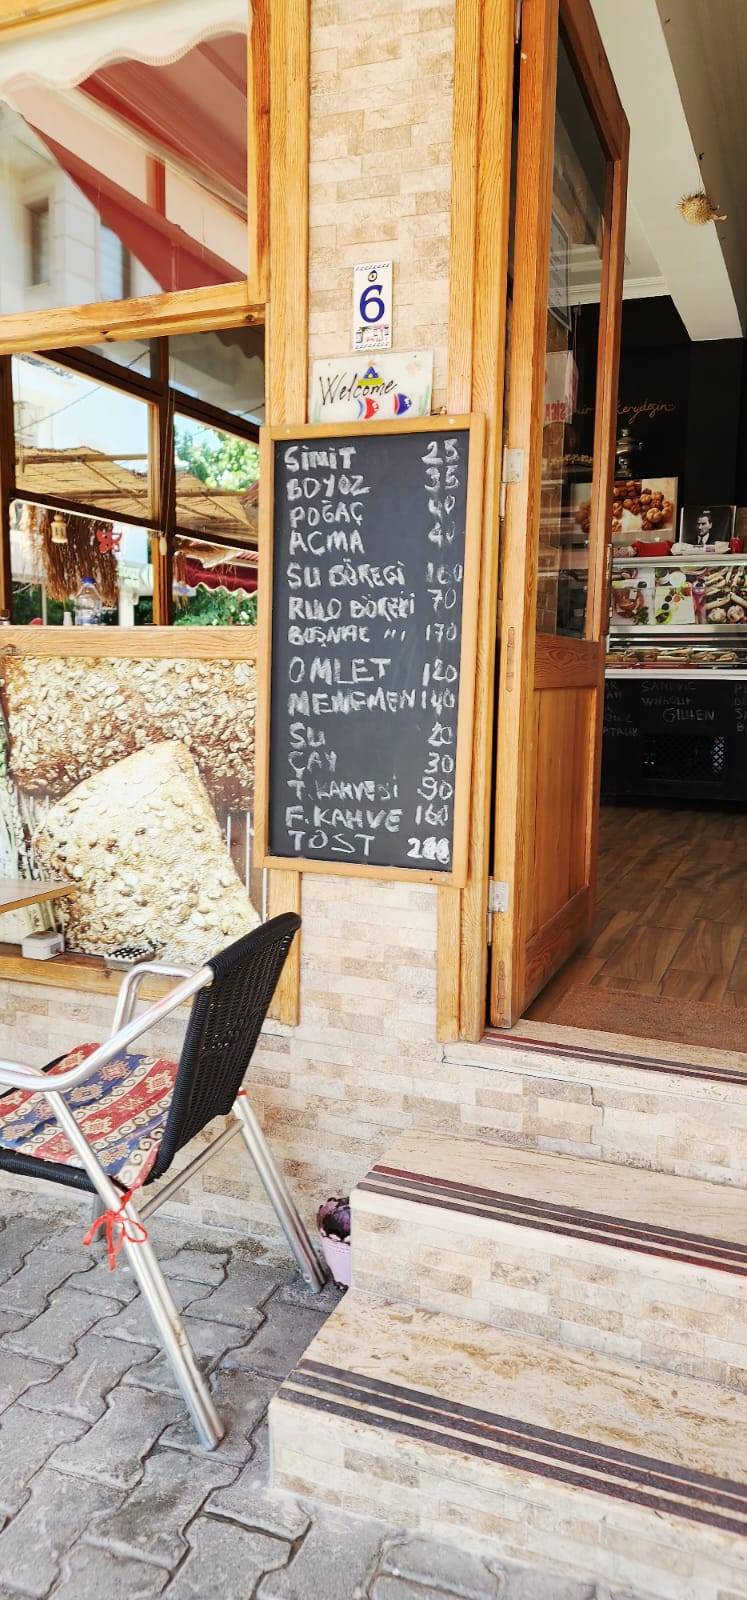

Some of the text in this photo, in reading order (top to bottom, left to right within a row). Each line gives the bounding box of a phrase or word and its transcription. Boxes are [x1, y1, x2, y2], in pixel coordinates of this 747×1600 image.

[360, 285, 385, 323] 6
[319, 372, 398, 406] Welcome
[421, 438, 459, 466] 25
[286, 465, 459, 501] BOYOZ 35
[427, 495, 456, 520] 40
[427, 520, 456, 547] 40
[286, 562, 322, 590] SU
[426, 561, 463, 585] 160
[427, 588, 457, 612] 70
[425, 621, 457, 643] 170
[288, 656, 458, 687] OMLET 120
[287, 687, 456, 717] MENEMEN 140
[289, 721, 453, 749] SU 20
[288, 750, 454, 779] ÇAY 30
[416, 776, 454, 801] 90
[313, 805, 404, 833] KAHVE
[414, 803, 449, 827] 160
[287, 830, 376, 857] TOST
